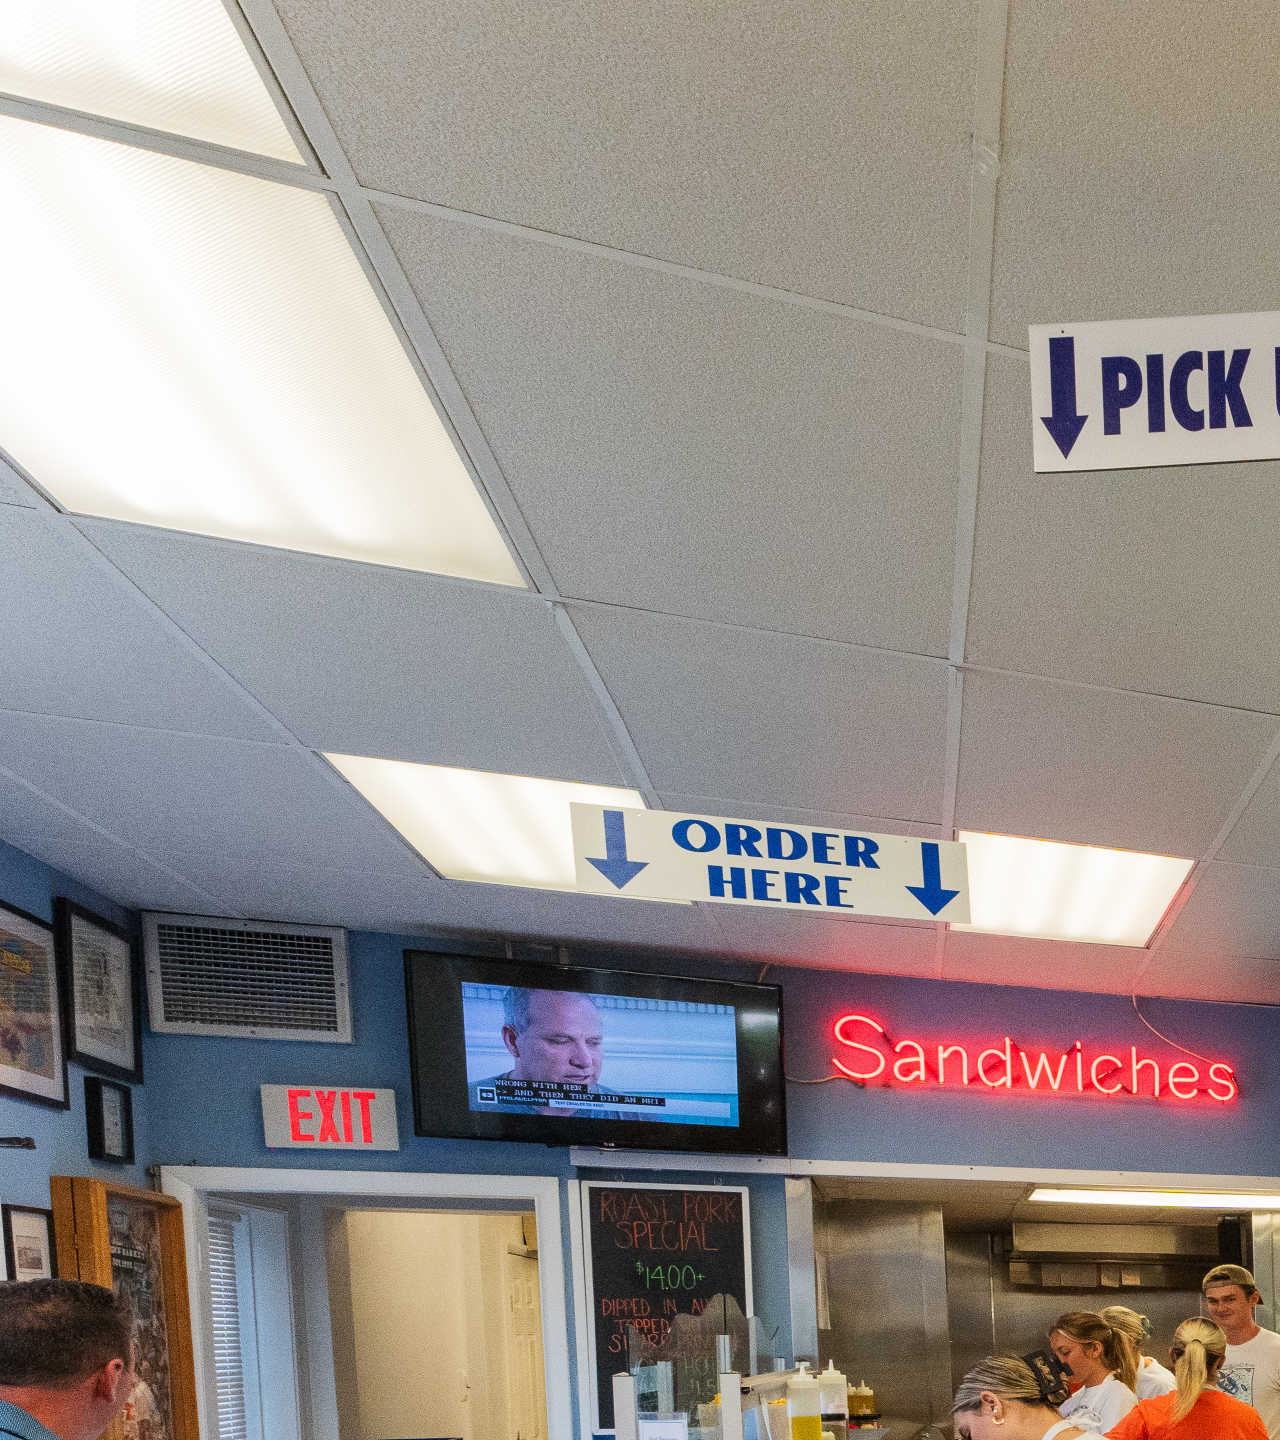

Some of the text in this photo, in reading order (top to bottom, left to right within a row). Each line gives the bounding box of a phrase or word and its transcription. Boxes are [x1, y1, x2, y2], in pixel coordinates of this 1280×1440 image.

[1101, 348, 1254, 436] PICK
[671, 818, 880, 869] ORDER
[707, 865, 855, 908] HERE
[832, 1014, 1239, 1102] Sandwiches
[495, 1079, 557, 1090] WRONG WITH
[540, 1091, 564, 1099] THEN
[600, 1095, 619, 1103] DID
[287, 1088, 376, 1144] EXIT
[600, 1191, 738, 1224] ROAST PORK
[615, 1220, 720, 1251] SPECIAL
[664, 1299, 677, 1315] IN
